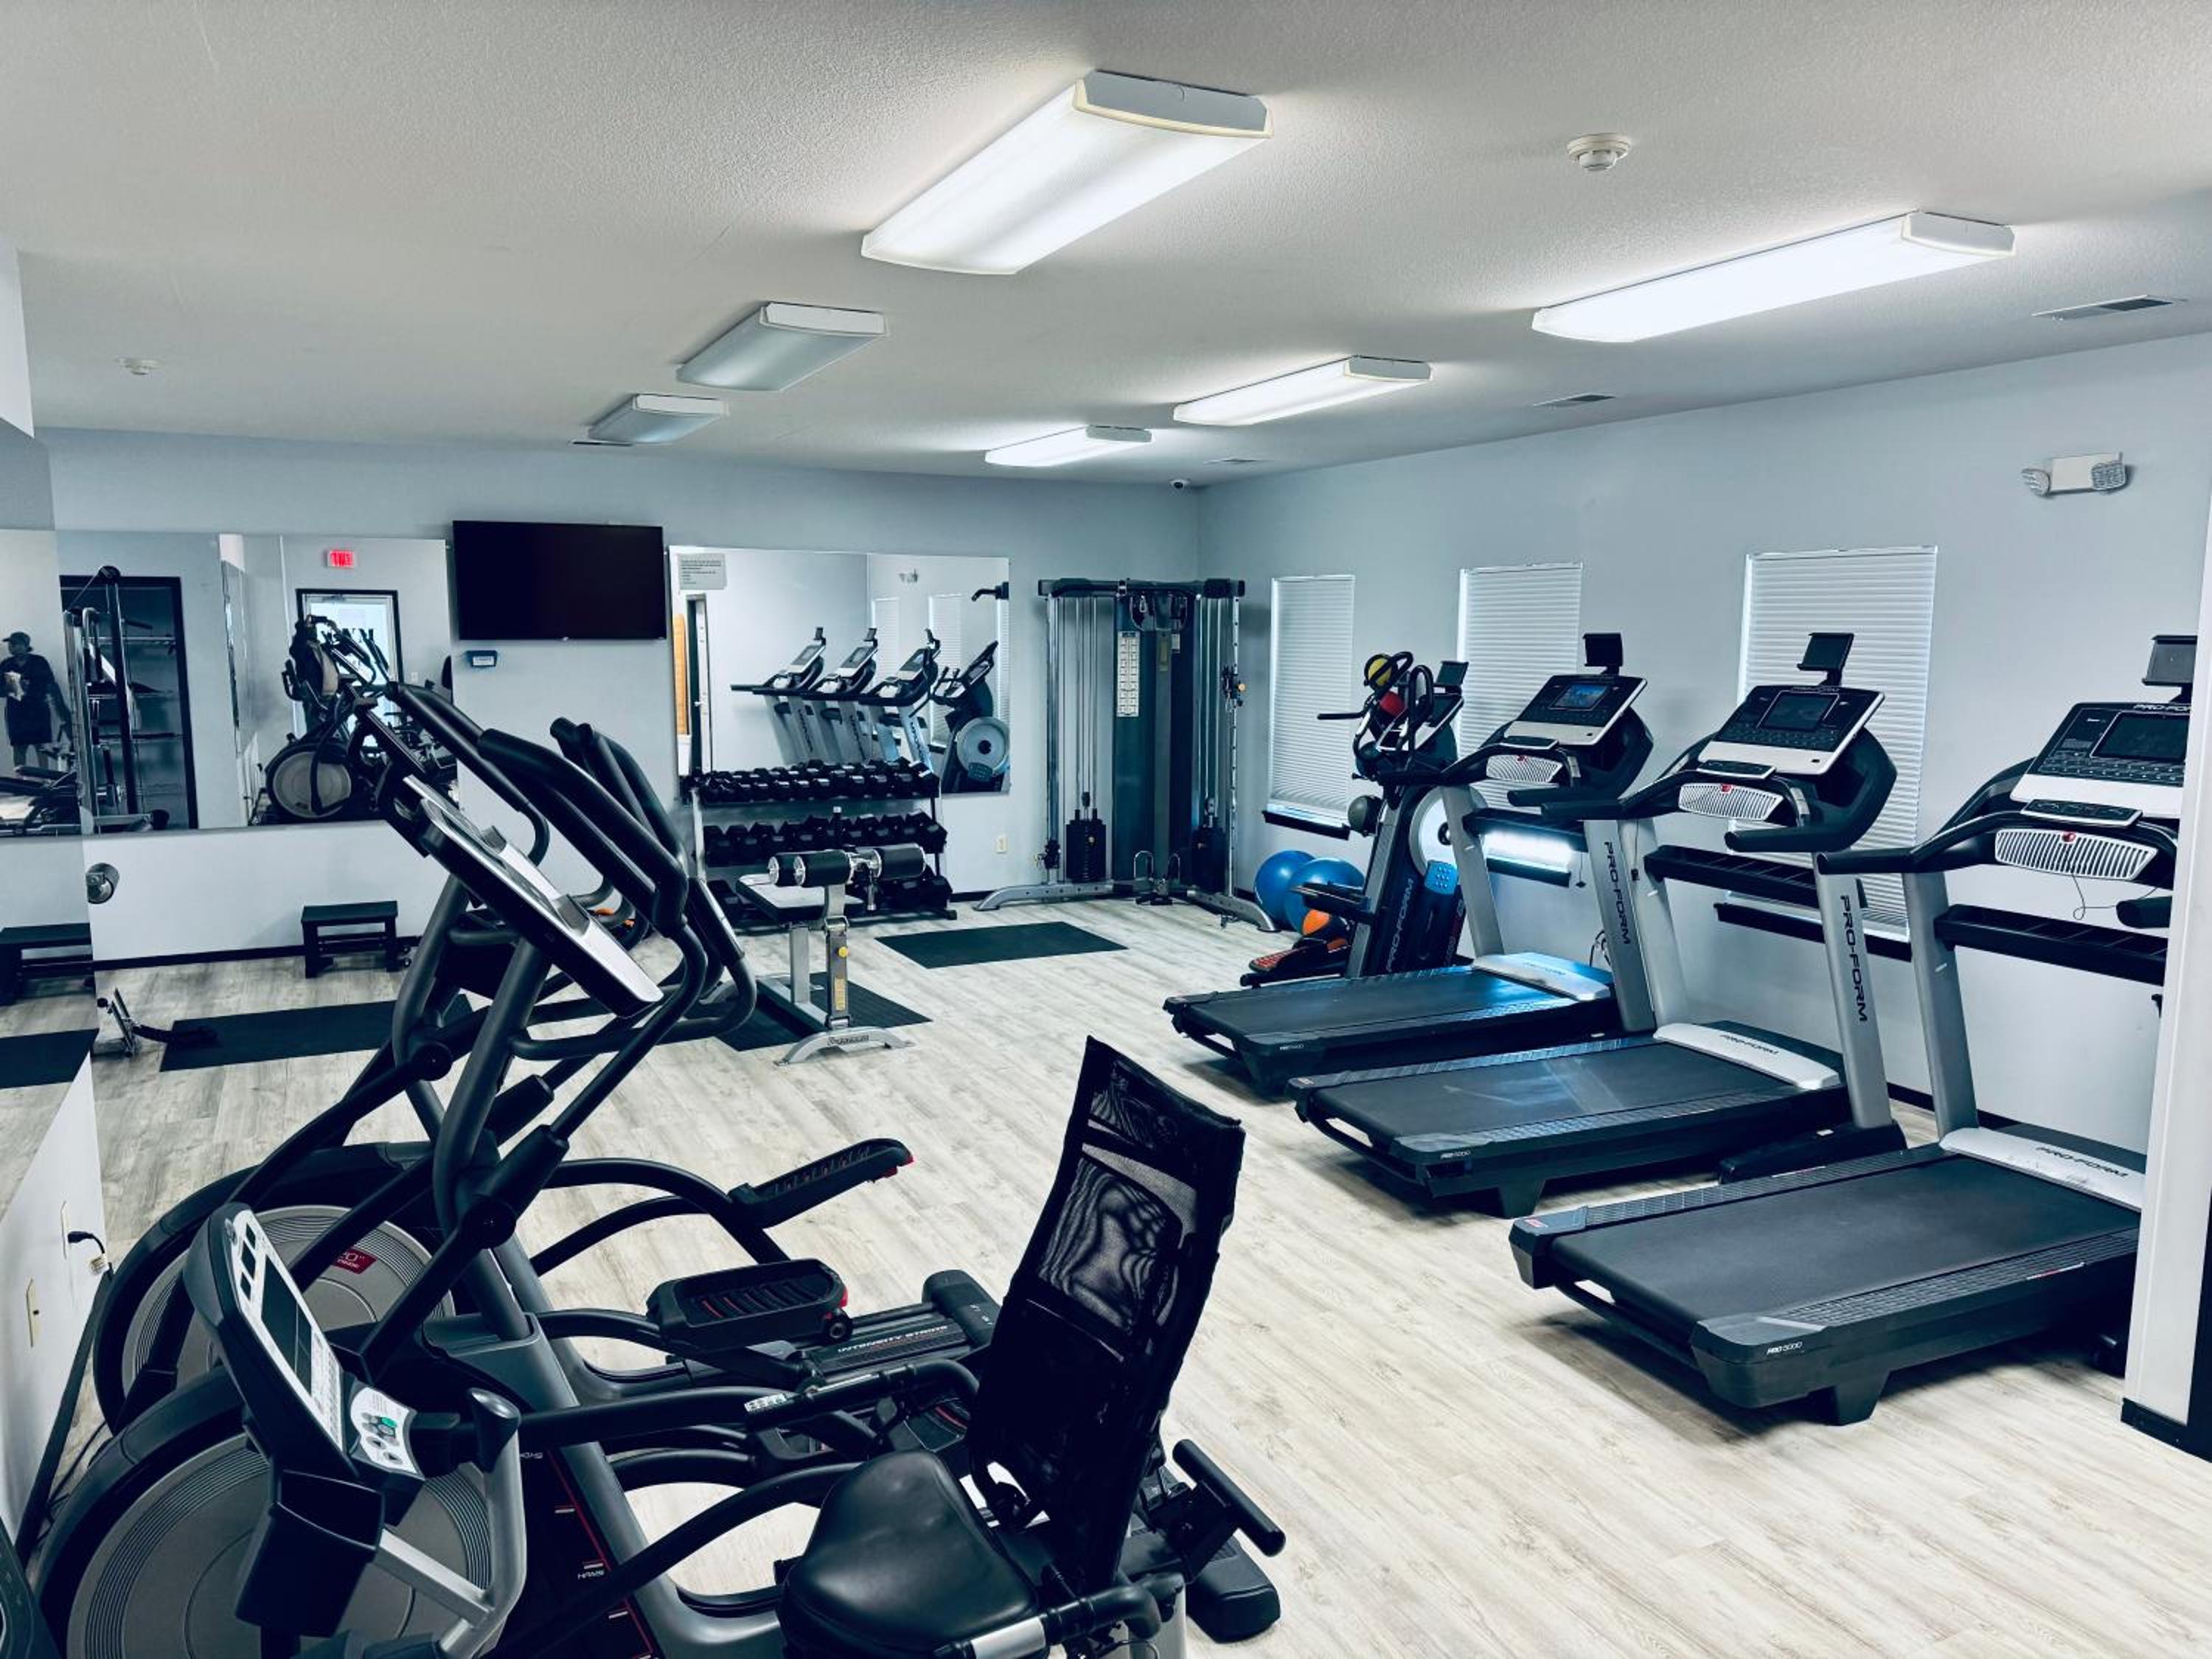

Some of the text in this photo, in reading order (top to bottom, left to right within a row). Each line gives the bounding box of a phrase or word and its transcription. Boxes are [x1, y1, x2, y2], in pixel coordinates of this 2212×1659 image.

[1604, 841, 1631, 945] PRO-FORM
[1840, 894, 1868, 1023] PRO-FORM
[2036, 1146, 2129, 1178] PRO-FORM
[837, 1335, 902, 1353] INTENSITY
[905, 1326, 948, 1338] STRIDE
